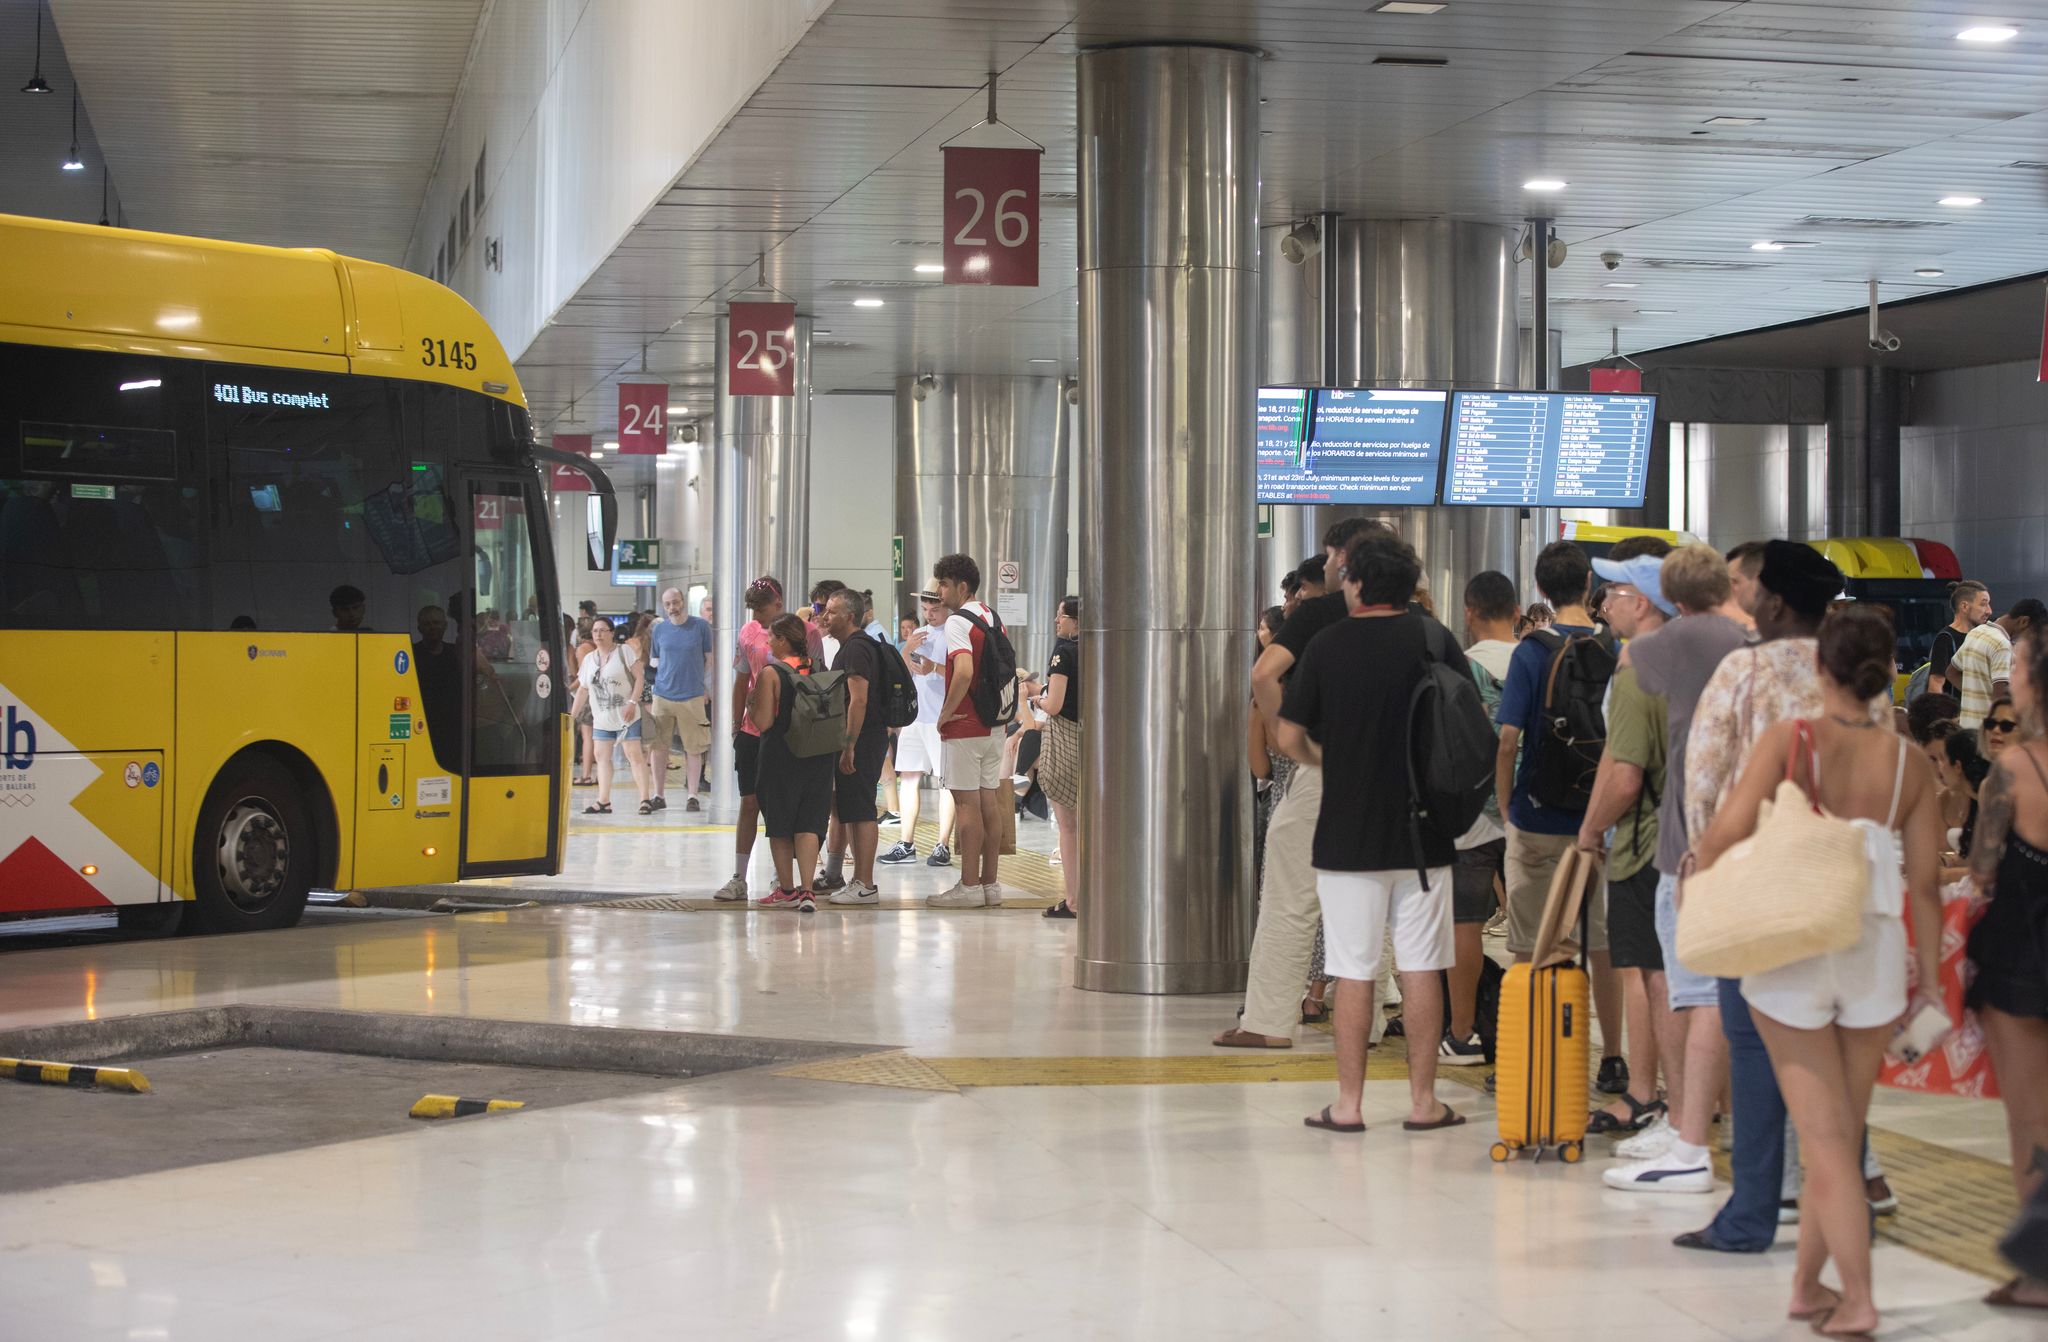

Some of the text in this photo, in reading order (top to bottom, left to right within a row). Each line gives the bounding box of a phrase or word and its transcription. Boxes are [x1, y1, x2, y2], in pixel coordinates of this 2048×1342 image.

[953, 187, 1030, 247] 26
[421, 337, 477, 371] 3145
[736, 329, 788, 370] 25
[214, 383, 330, 409] 401 Bus complet
[622, 403, 664, 436] 24
[1325, 406, 1352, 414] reducció
[1389, 442, 1401, 450] por
[1401, 442, 1421, 450] huelga
[1285, 483, 1318, 492] transports
[1305, 475, 1320, 483] July,
[1400, 475, 1424, 483] general
[478, 500, 500, 519] 21
